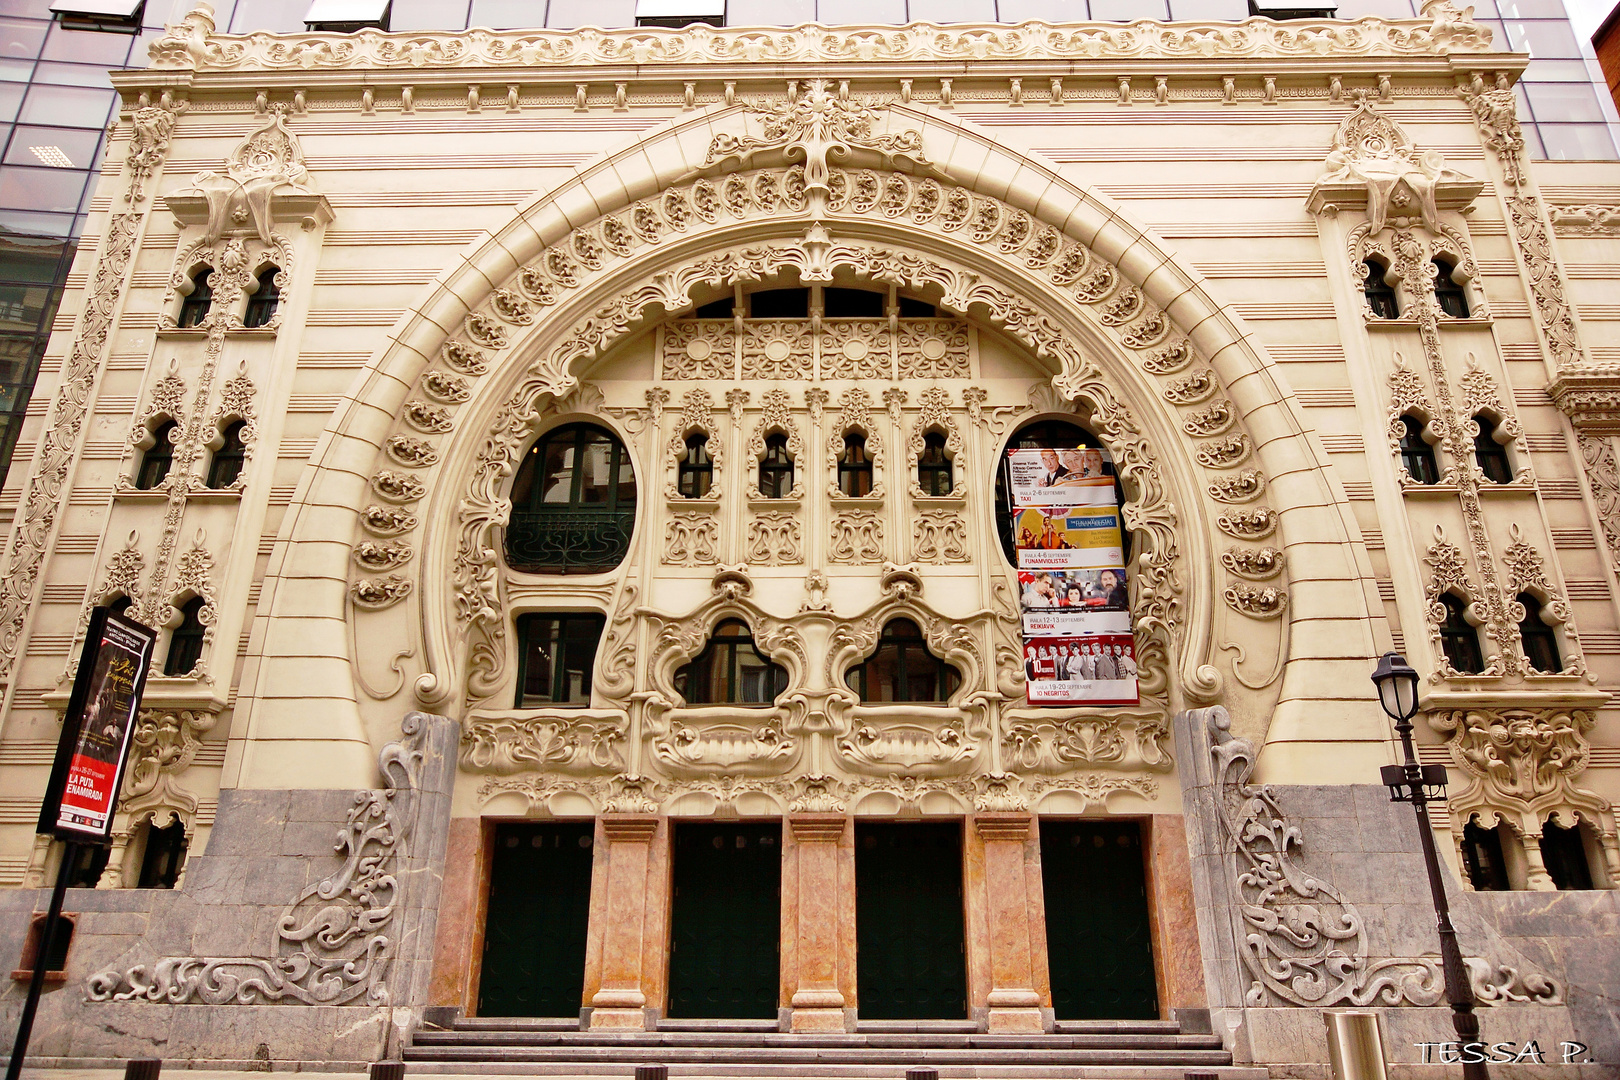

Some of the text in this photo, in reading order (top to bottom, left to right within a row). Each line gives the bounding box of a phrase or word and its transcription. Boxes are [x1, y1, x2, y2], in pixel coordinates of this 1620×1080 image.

[1033, 660, 1041, 673] 10
[69, 774, 94, 788] LA PUTA
[67, 784, 103, 801] ENAMORADA
